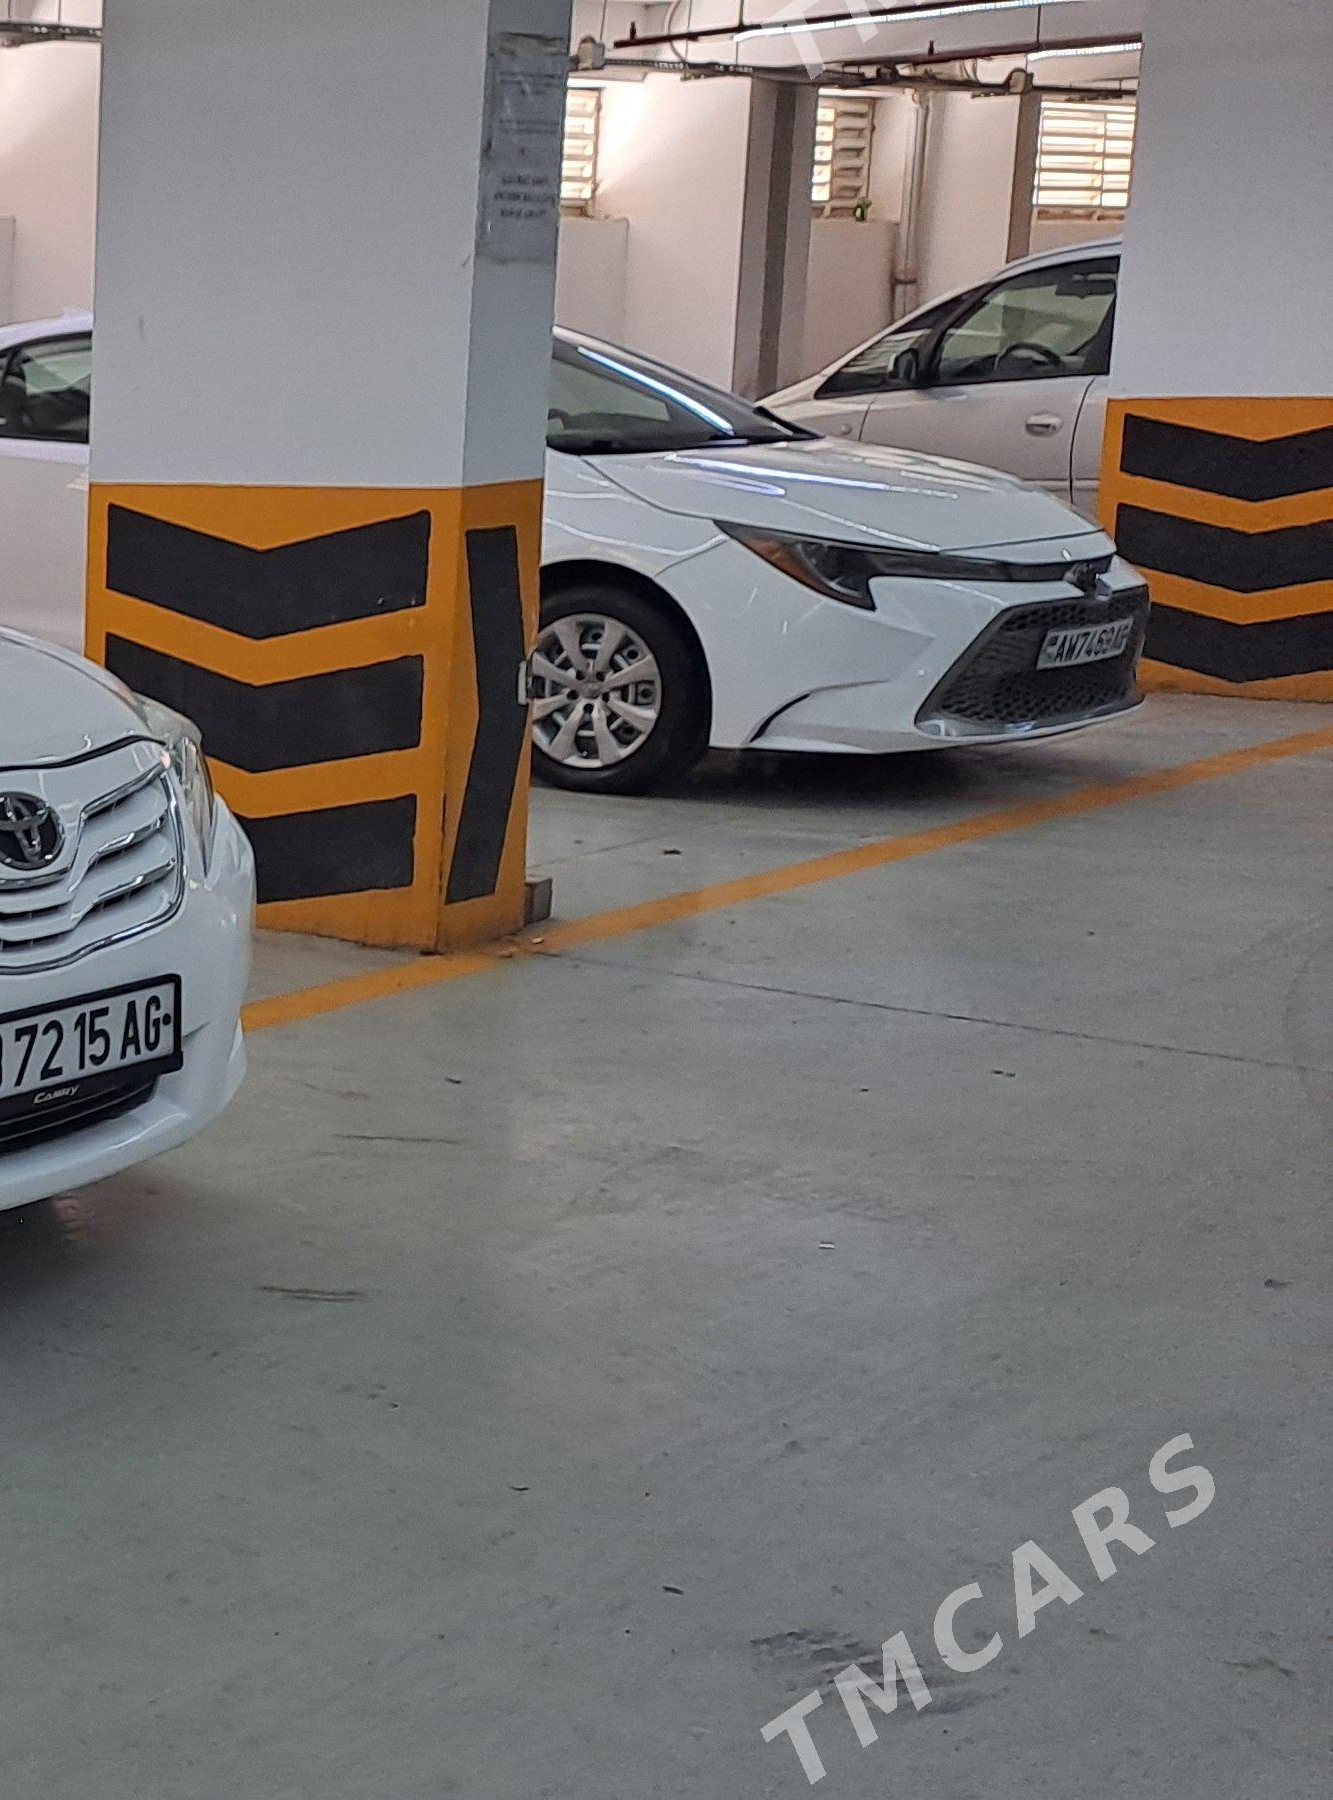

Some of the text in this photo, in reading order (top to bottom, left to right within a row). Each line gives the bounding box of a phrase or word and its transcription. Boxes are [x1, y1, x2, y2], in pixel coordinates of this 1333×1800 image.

[13, 1019, 64, 1087] 72
[74, 1006, 111, 1070] 15
[120, 995, 161, 1060] AG
